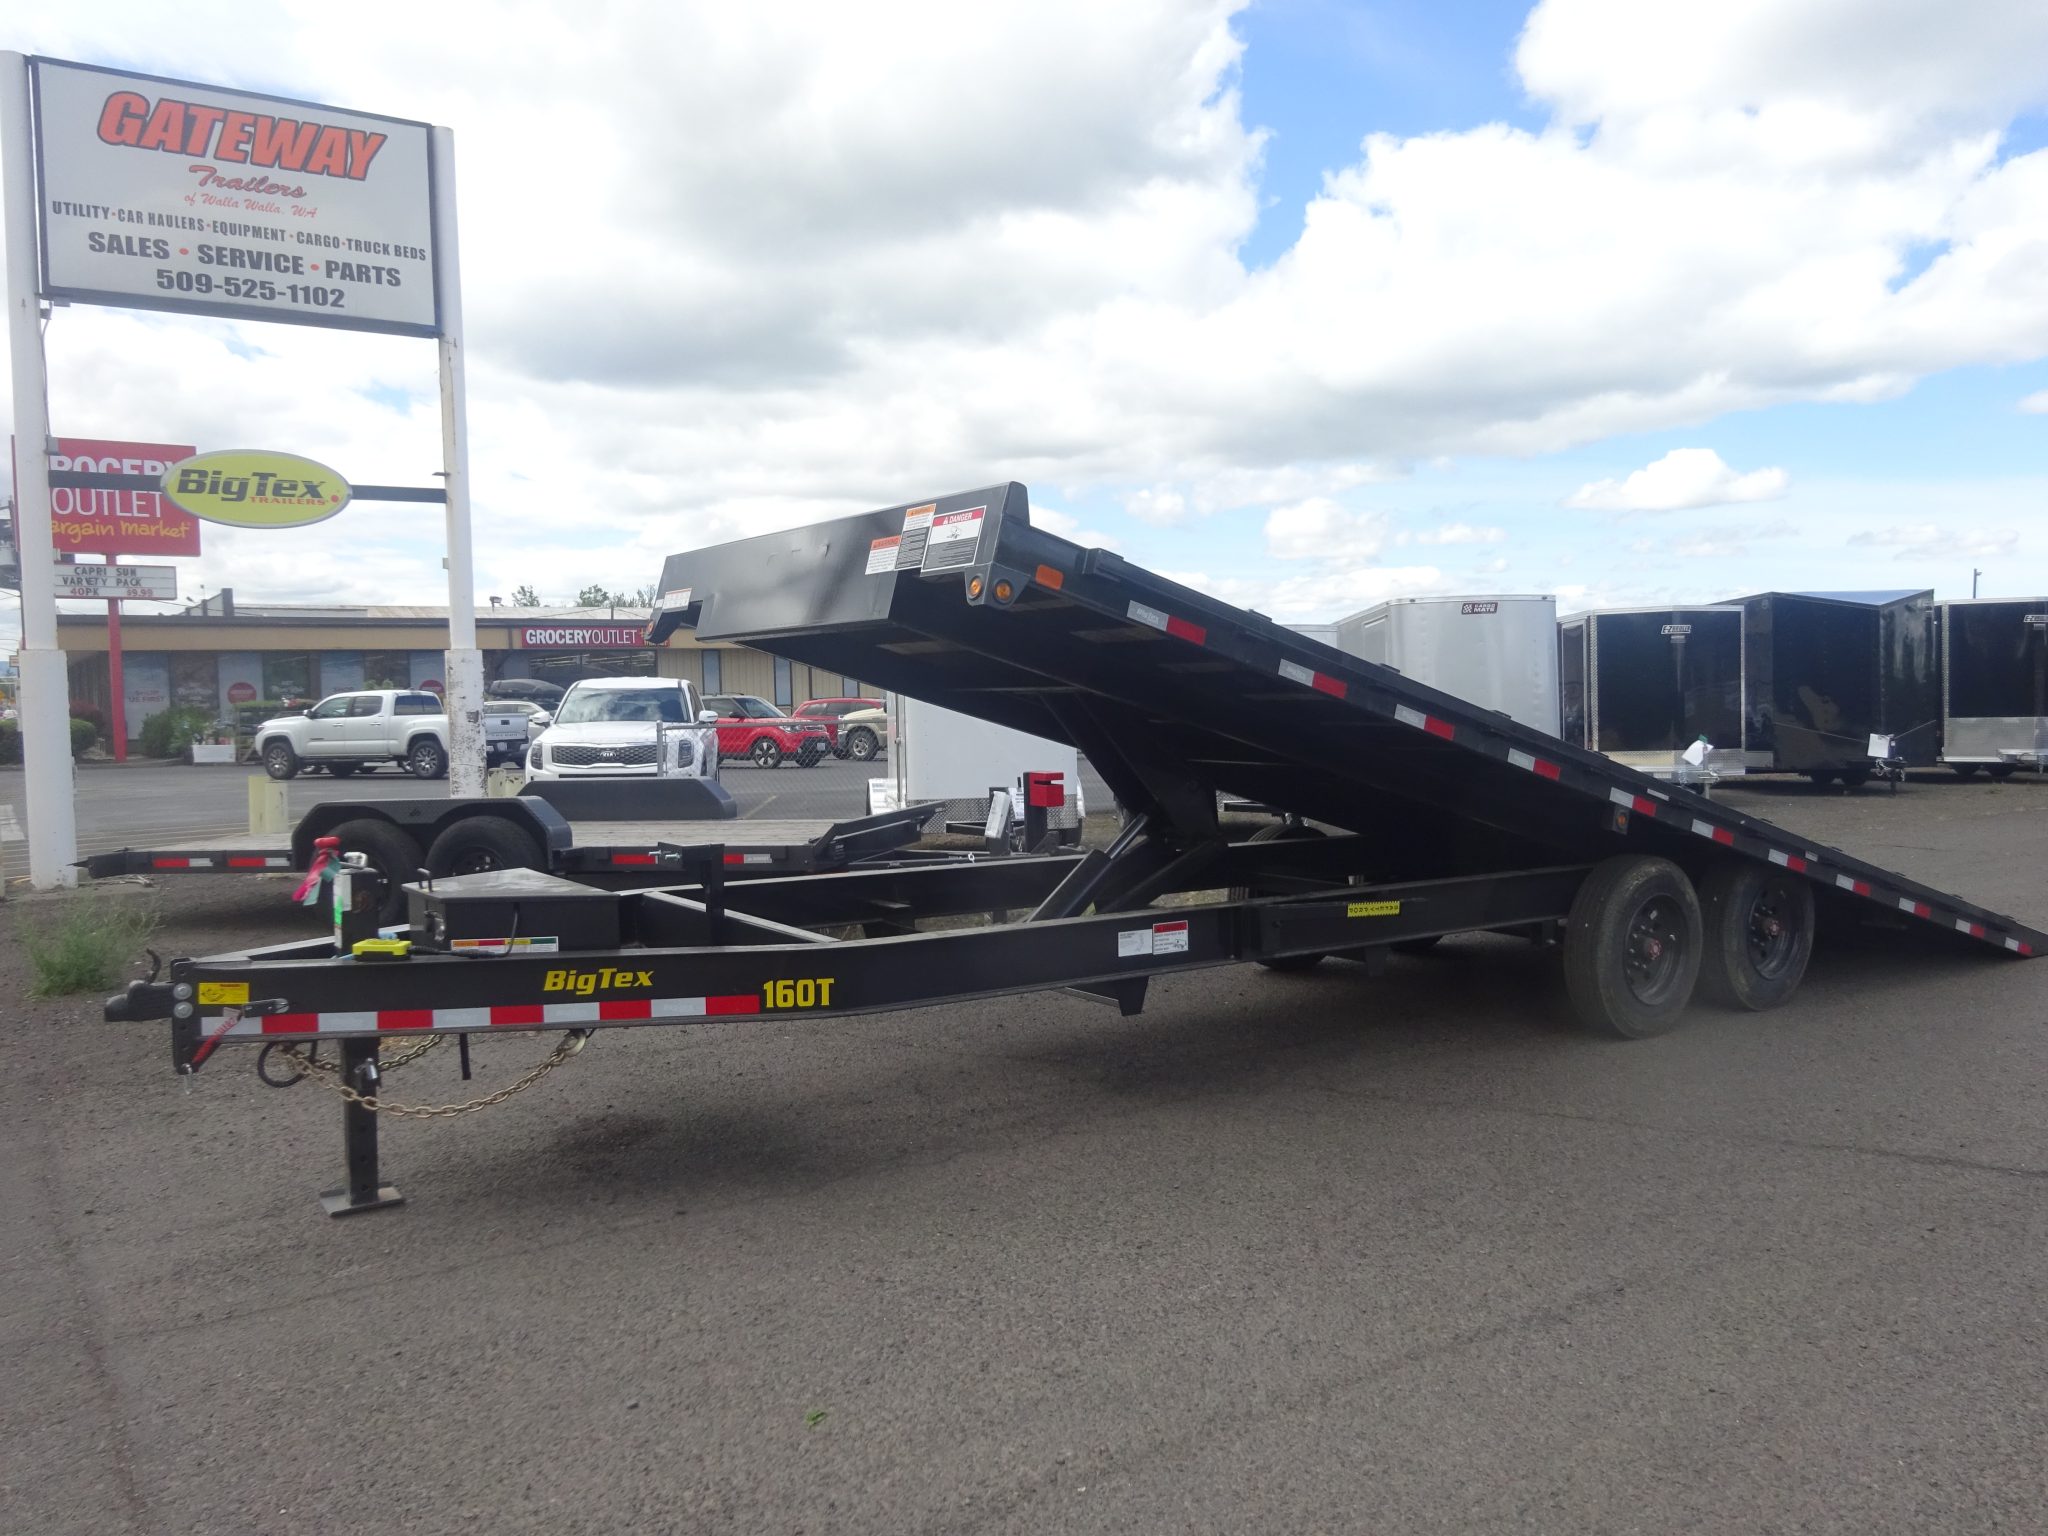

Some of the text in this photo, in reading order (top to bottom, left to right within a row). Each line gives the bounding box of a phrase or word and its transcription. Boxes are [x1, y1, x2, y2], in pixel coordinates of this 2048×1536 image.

[97, 91, 388, 181] GATEWAY
[189, 165, 307, 198] Trailers
[184, 192, 196, 206] of
[201, 193, 239, 208] Walla
[290, 205, 318, 218] WA
[52, 200, 426, 261] UTILITY CAR HAULERS EQUIPMENT CARGO TRUCK BEDS
[88, 231, 401, 287] SALES SERVICE PARTS
[157, 269, 345, 308] 509-525-1102
[51, 487, 163, 518] OUTLET
[250, 496, 326, 506] TRAILERS
[51, 519, 115, 543] argain
[949, 512, 973, 525] DANGER
[74, 566, 137, 577] CAPRI SUN
[116, 578, 142, 587] PACK
[543, 968, 654, 996] BigTex
[763, 978, 834, 1008] 160T
